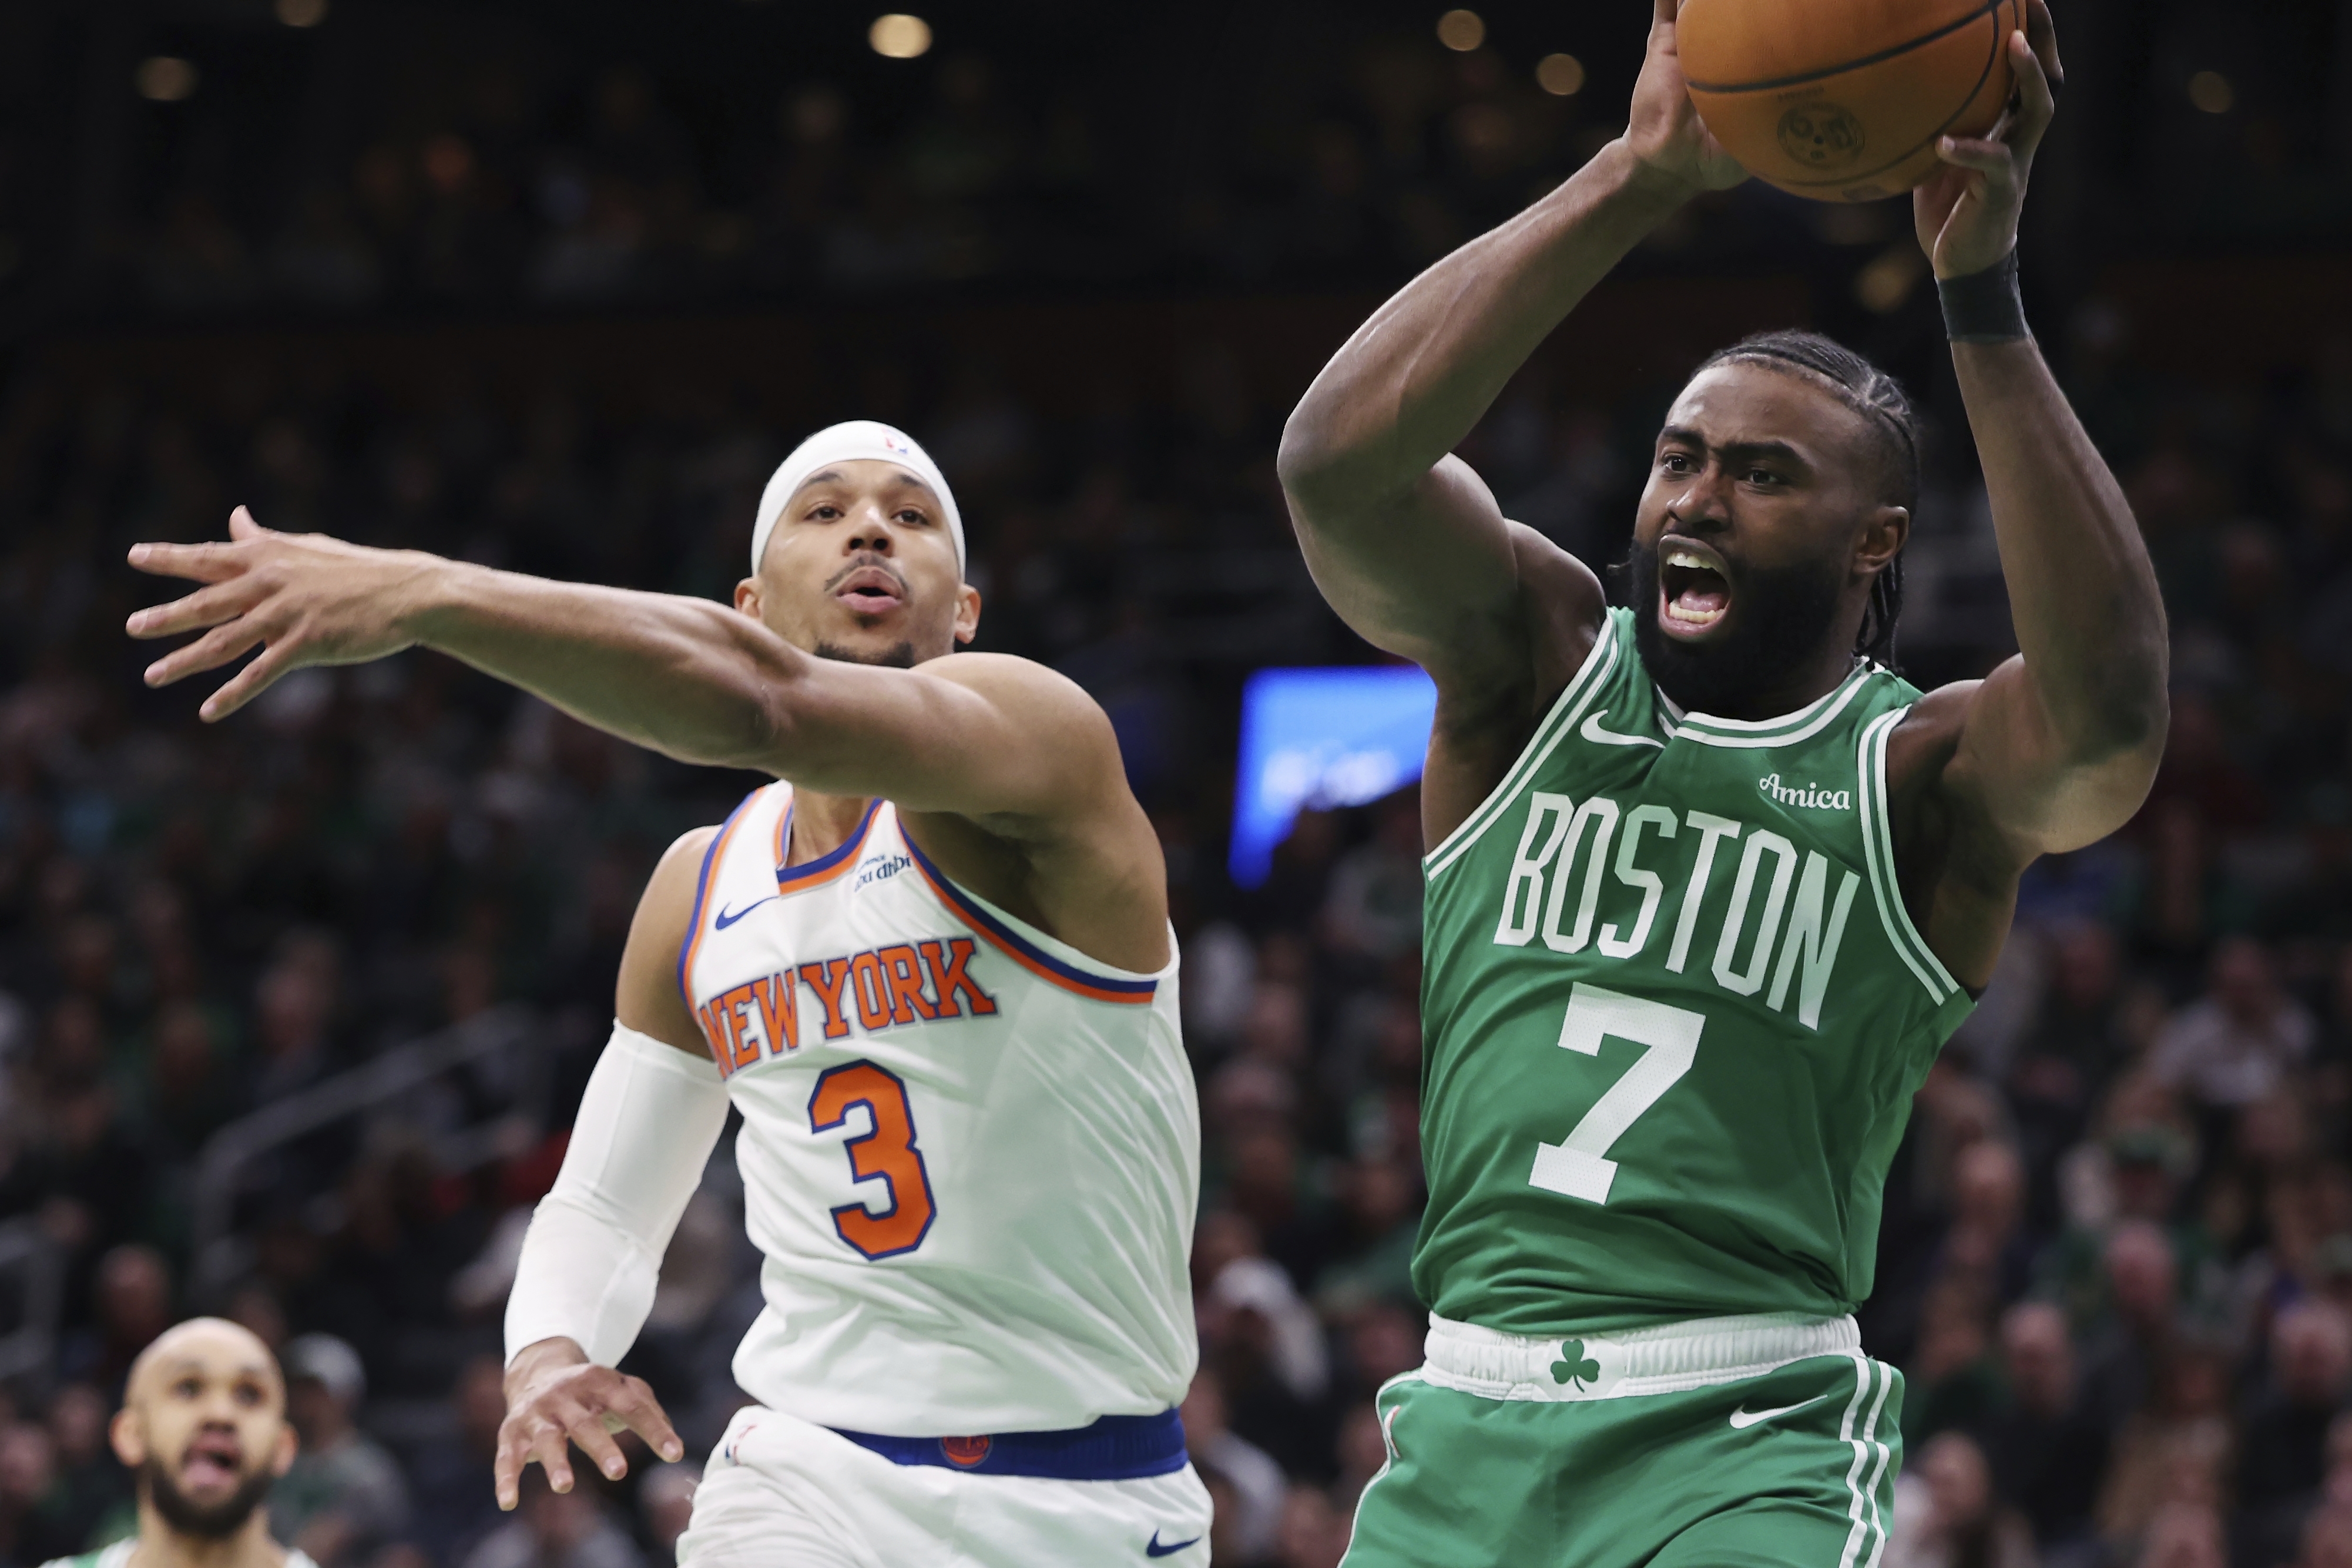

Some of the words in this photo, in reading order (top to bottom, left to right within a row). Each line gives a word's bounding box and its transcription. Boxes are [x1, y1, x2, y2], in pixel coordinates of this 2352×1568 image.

[1759, 773, 1851, 810] Amica
[699, 969, 800, 1082] NEW
[798, 938, 998, 1039] YORK
[1494, 791, 1860, 1030] BOSTON
[807, 1058, 937, 1261] 3
[1529, 982, 1706, 1206] 7
